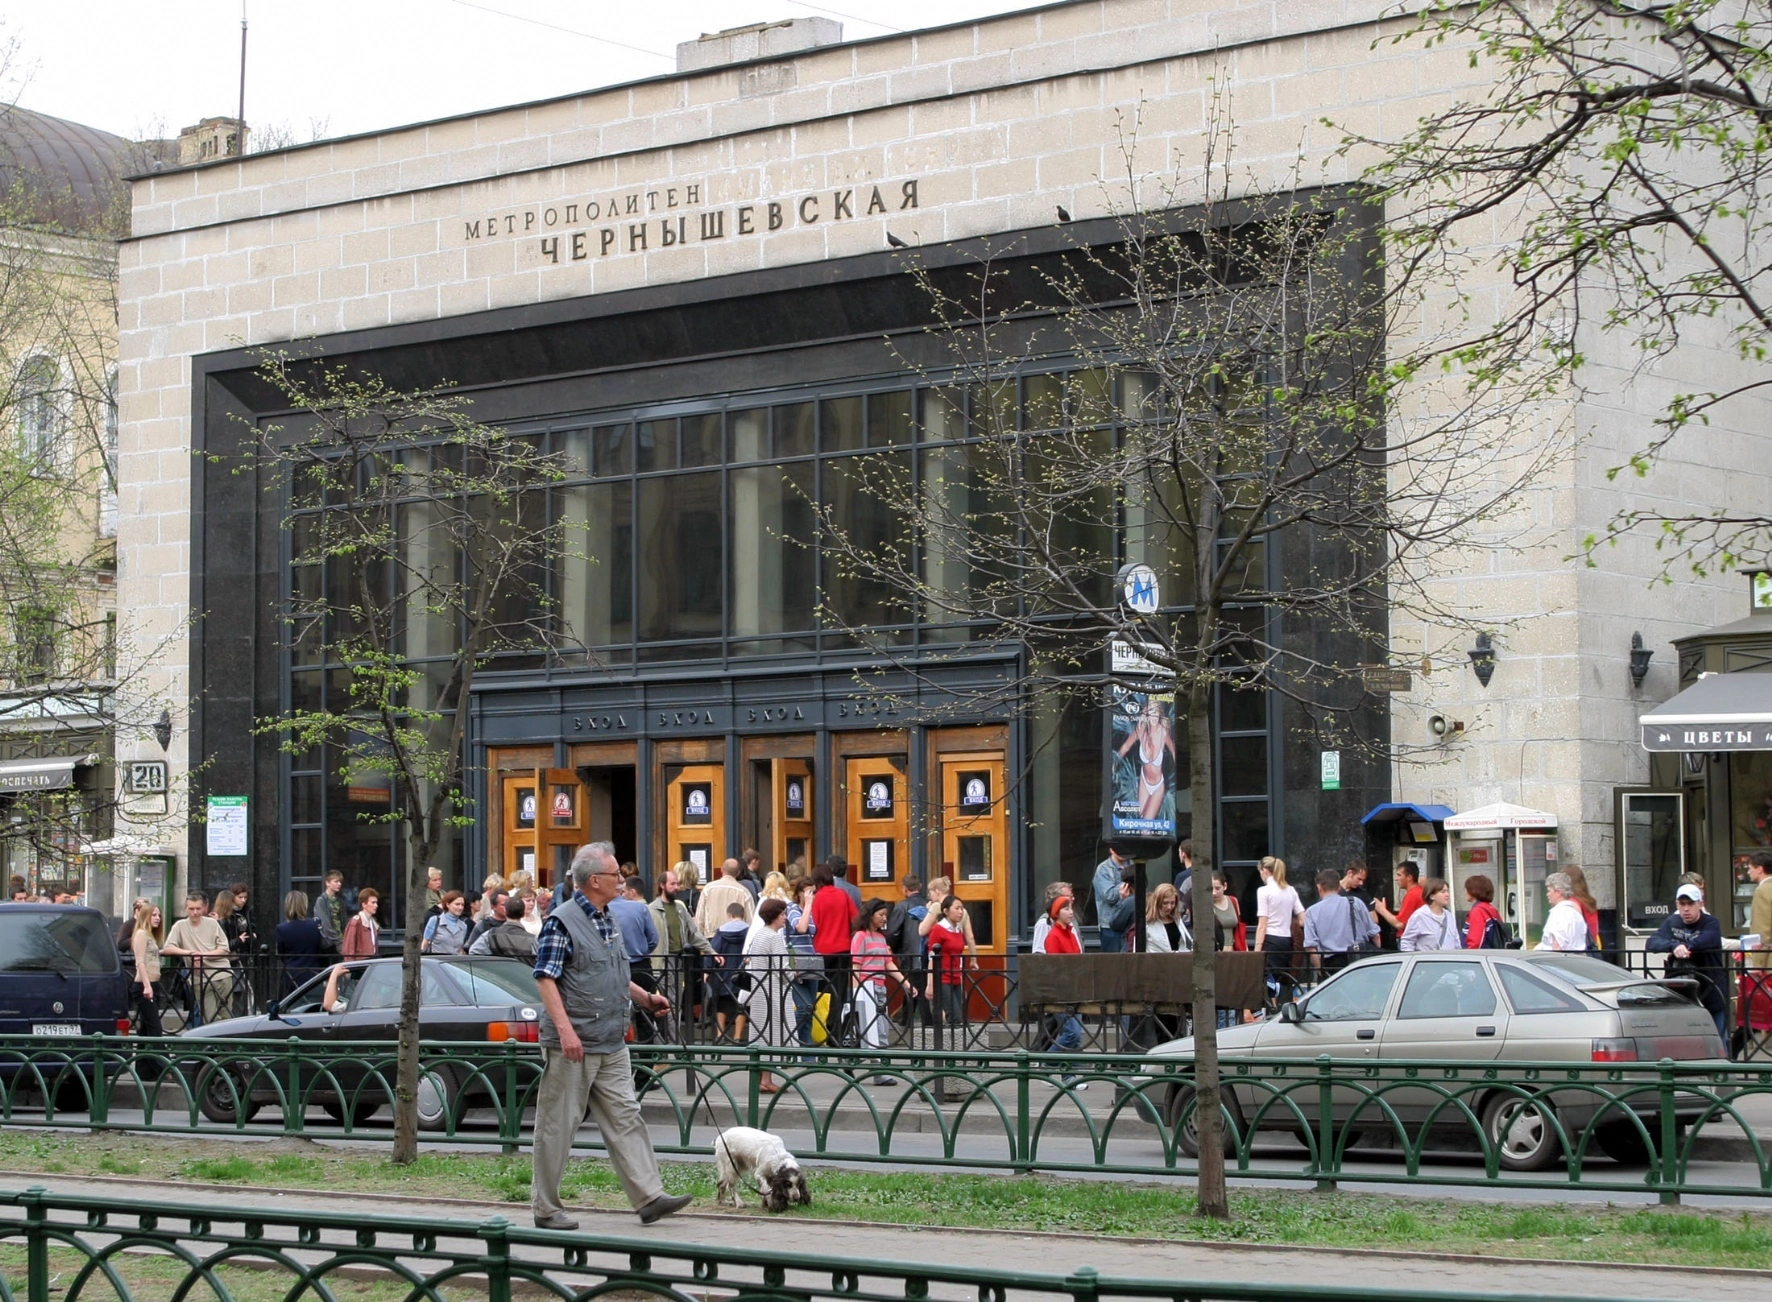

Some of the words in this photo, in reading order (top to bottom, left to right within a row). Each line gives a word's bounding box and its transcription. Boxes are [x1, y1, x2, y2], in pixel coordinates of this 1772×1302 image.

[465, 184, 700, 240] МЕТРОПОЛИТЕН
[541, 180, 919, 264] ЧЕРНЫШЕВСКАЯ
[748, 705, 803, 722] ВХОД
[838, 701, 898, 717] ВХОД
[573, 714, 627, 730] ВХОД
[659, 710, 714, 726] ВХОД
[1683, 730, 1752, 746] ЦВЕТЫ
[135, 766, 162, 788] 20
[1118, 819, 1153, 829] Кирочная
[1510, 817, 1547, 825] Городской
[1645, 905, 1669, 915] ВХОД
